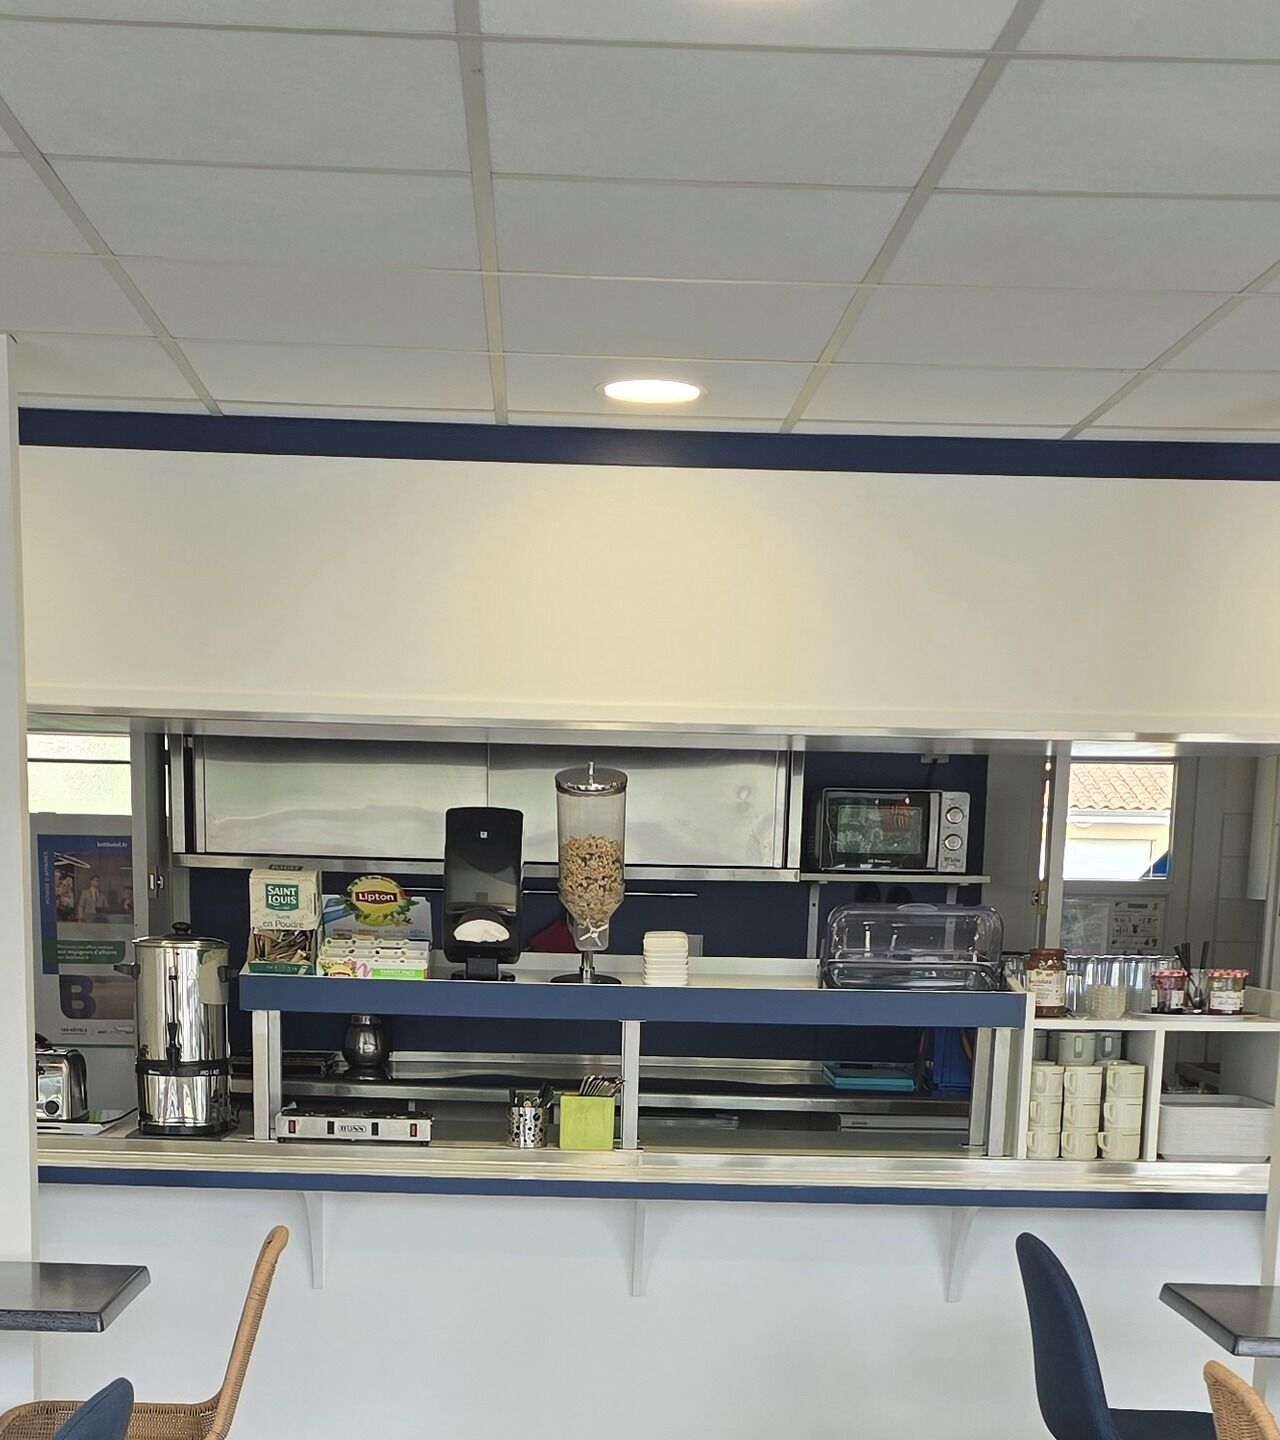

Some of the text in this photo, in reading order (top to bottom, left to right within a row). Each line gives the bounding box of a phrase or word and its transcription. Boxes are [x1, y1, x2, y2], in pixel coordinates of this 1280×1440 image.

[267, 886, 297, 895] SAINT
[268, 896, 297, 906] LOUIS
[358, 893, 395, 902] Lipton
[275, 920, 304, 928] Poudre
